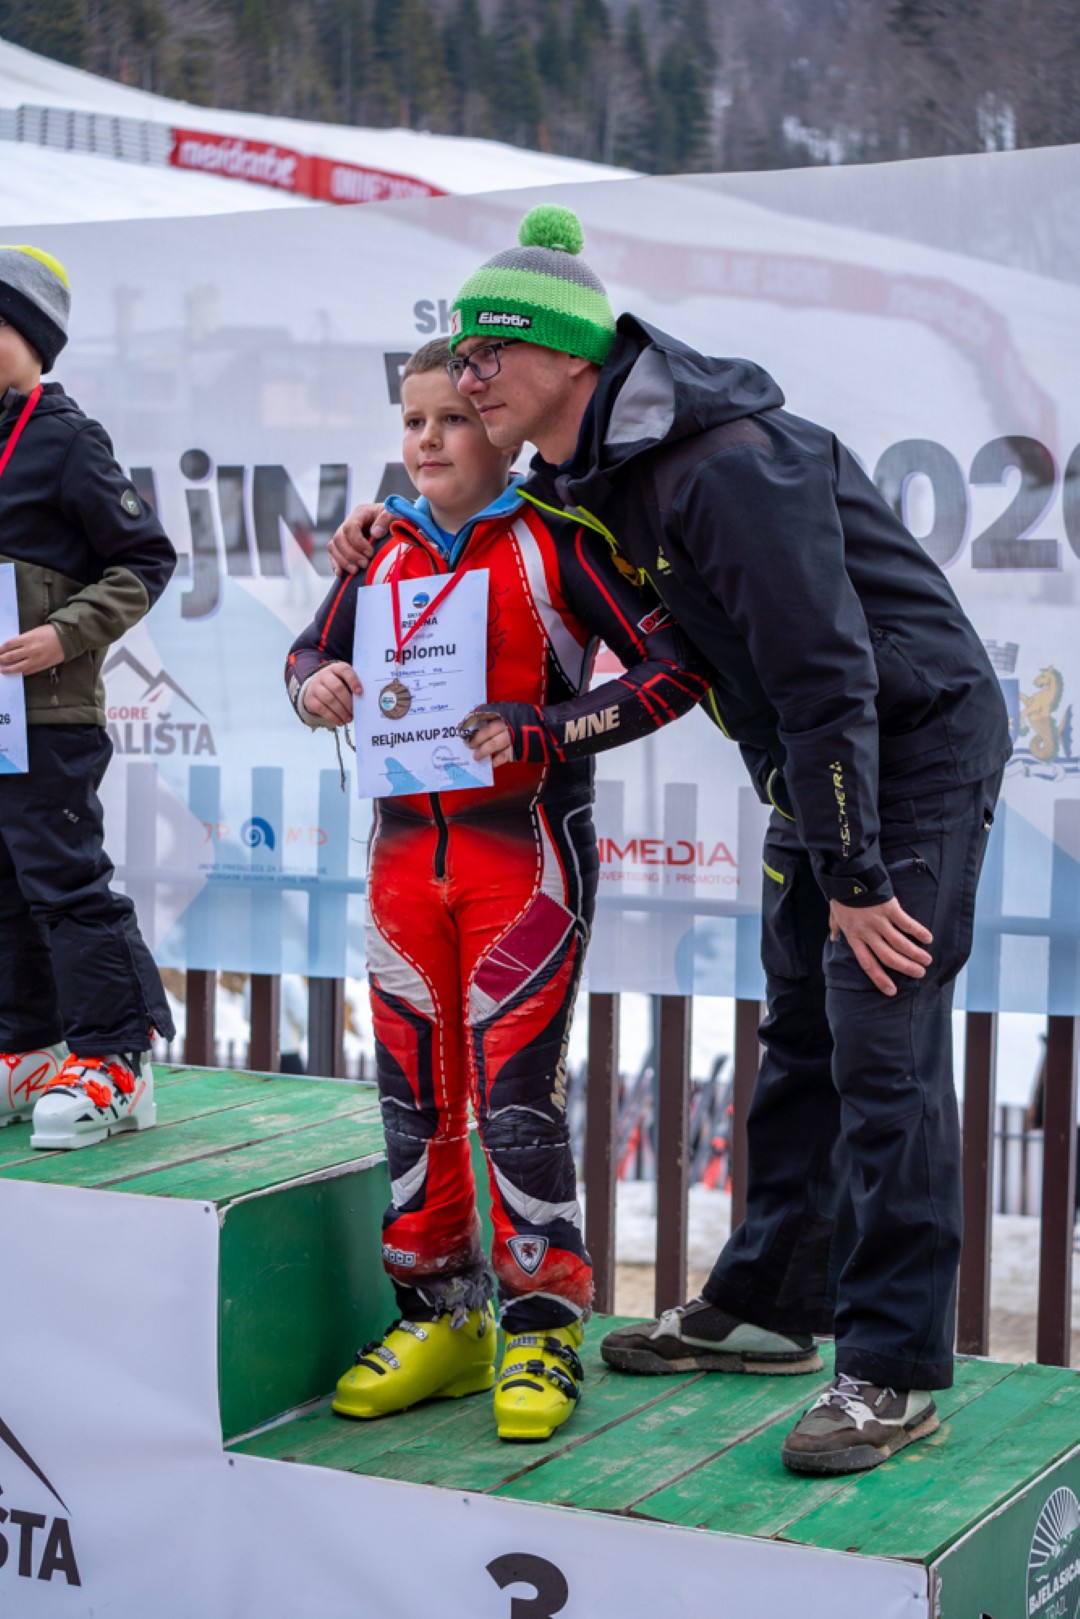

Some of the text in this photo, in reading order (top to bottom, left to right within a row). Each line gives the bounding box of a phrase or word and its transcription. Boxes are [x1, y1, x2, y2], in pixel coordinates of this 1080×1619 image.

[852, 435, 1080, 570] 02
[385, 643, 456, 666] Dplomu
[108, 706, 149, 720] GORE
[564, 705, 620, 744] MNE
[416, 729, 440, 742] KUP
